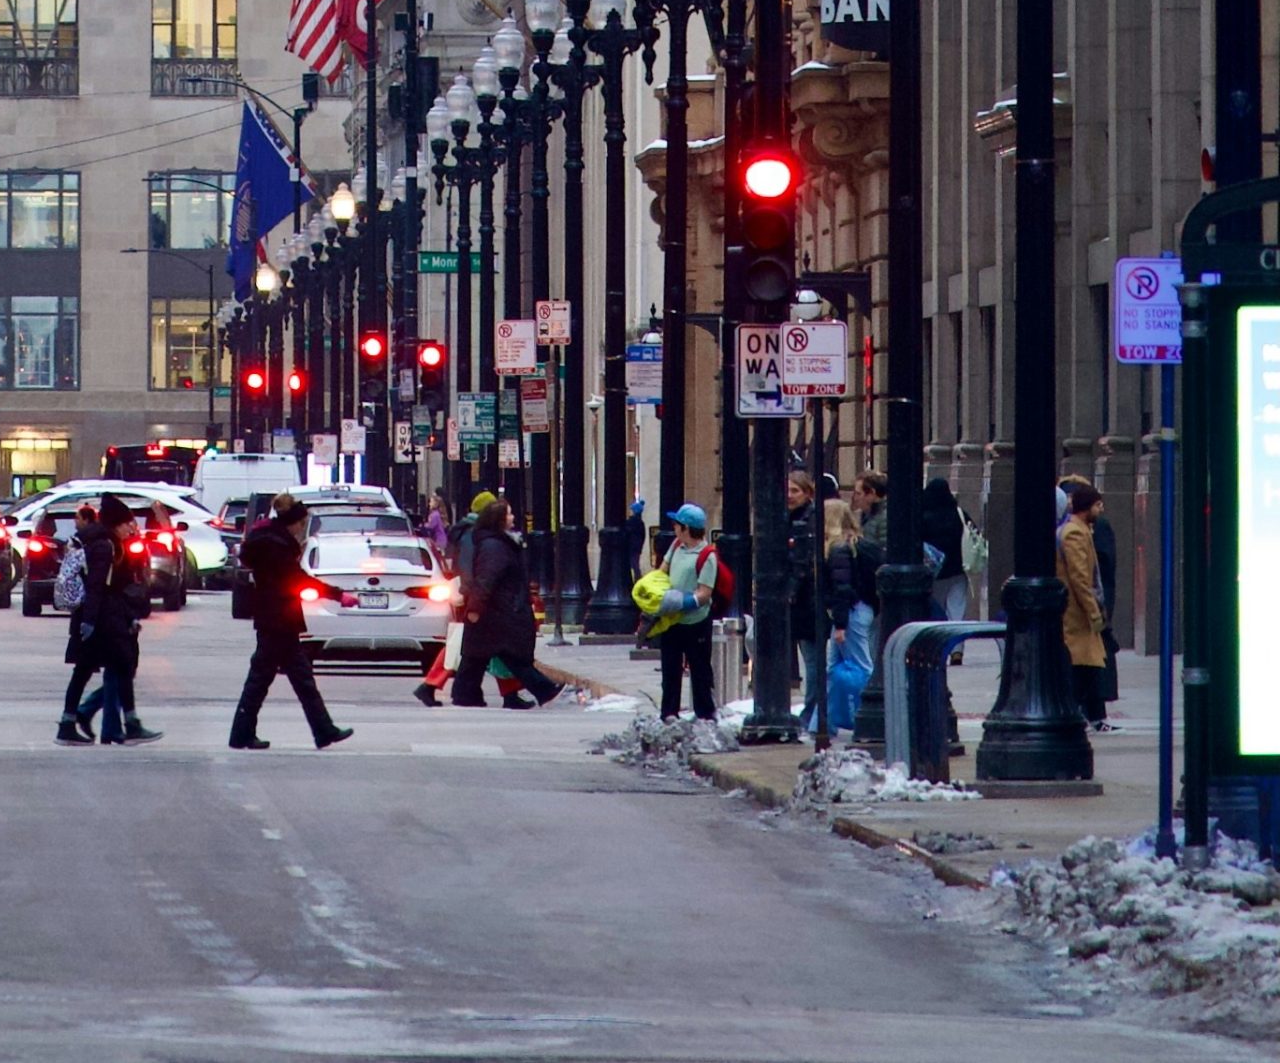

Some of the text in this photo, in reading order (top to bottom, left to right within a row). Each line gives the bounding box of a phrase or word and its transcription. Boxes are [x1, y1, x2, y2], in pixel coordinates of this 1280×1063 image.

[432, 256, 458, 268] Monr
[1124, 309, 1180, 319] NO STOPP
[1124, 320, 1178, 330] NO STAND
[747, 334, 780, 354] ON
[1125, 346, 1157, 359] TOW
[745, 358, 780, 379] WA
[787, 385, 841, 394] TOW ZONE
